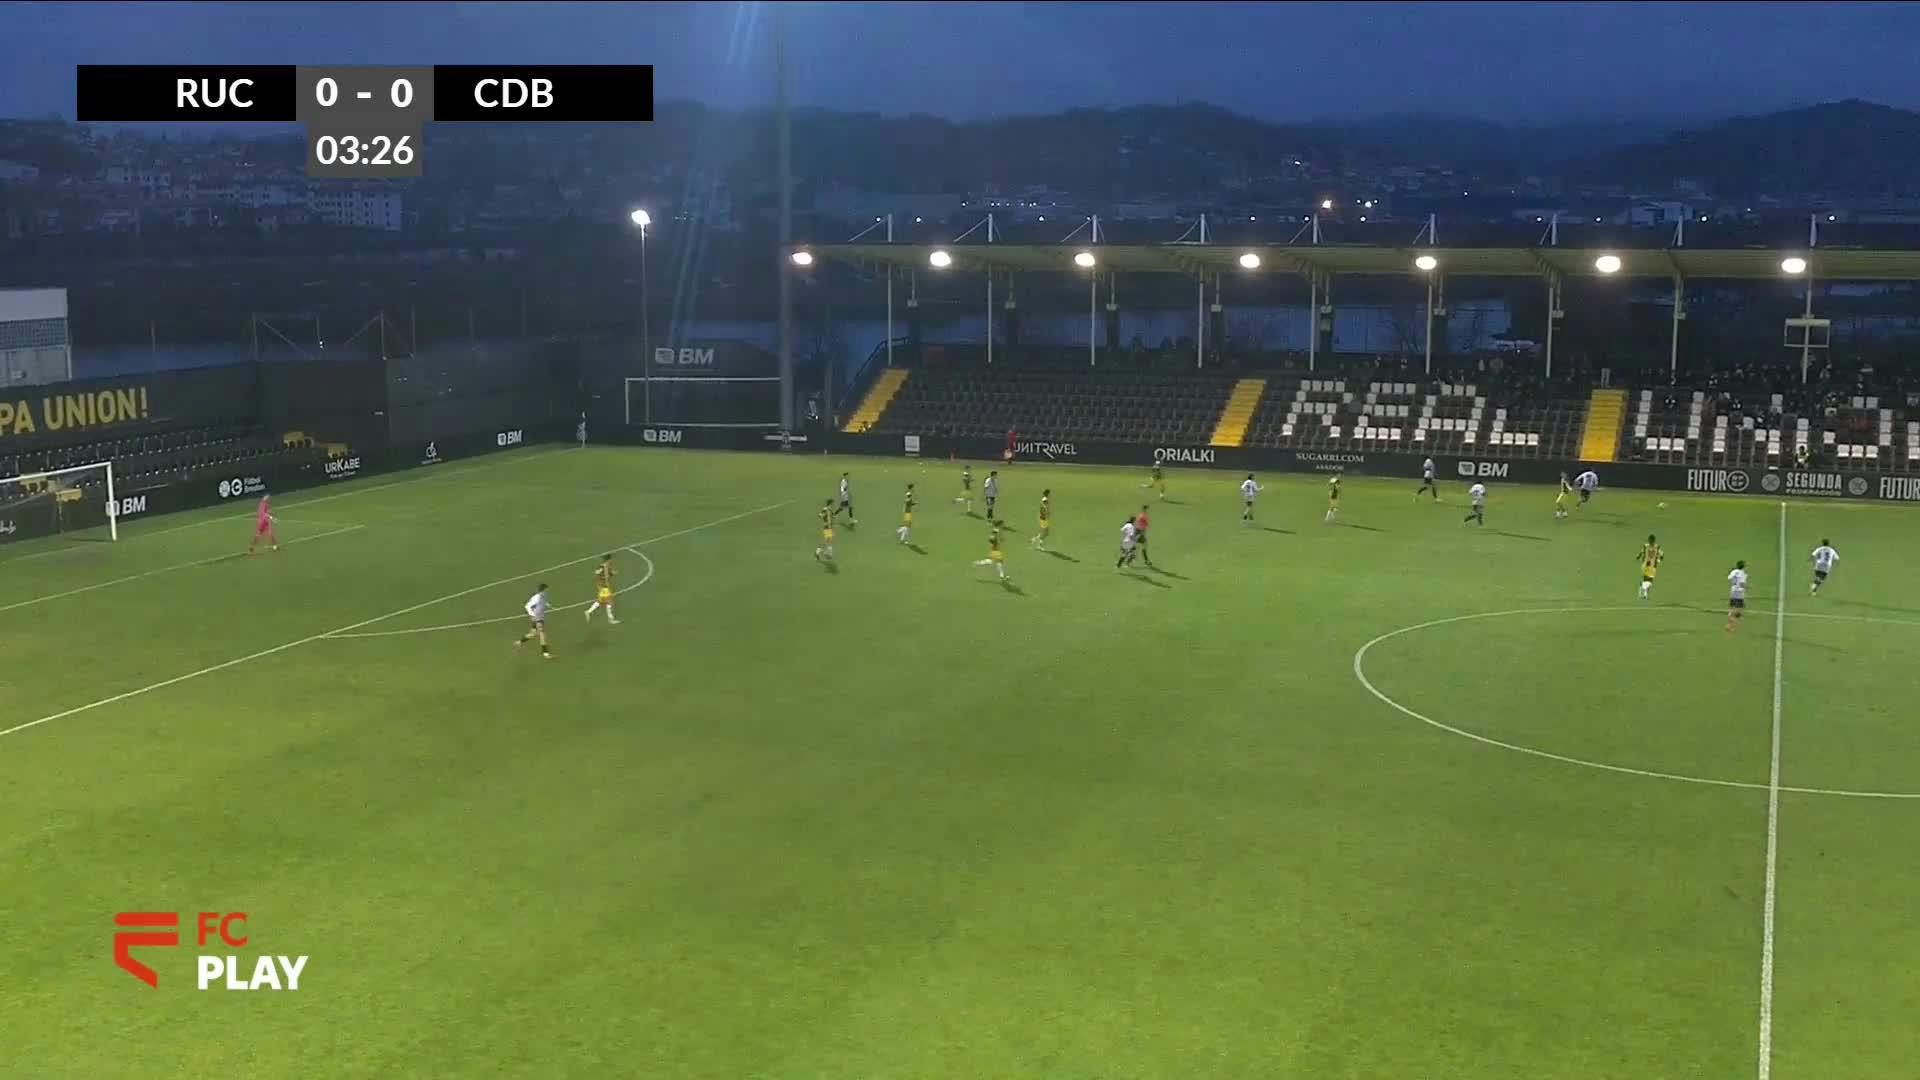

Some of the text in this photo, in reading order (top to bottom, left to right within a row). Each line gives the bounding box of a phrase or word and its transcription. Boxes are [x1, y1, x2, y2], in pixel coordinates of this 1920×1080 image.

[678, 347, 714, 364] BM
[43, 387, 148, 430] UNION!
[1281, 379, 1539, 446] REAL
[507, 430, 522, 444] BM
[658, 430, 682, 443] BM
[1154, 448, 1214, 463] ORIALKI
[1477, 462, 1509, 477] BM
[1786, 472, 1842, 489] SEGUNDA
[122, 494, 147, 516] BM
